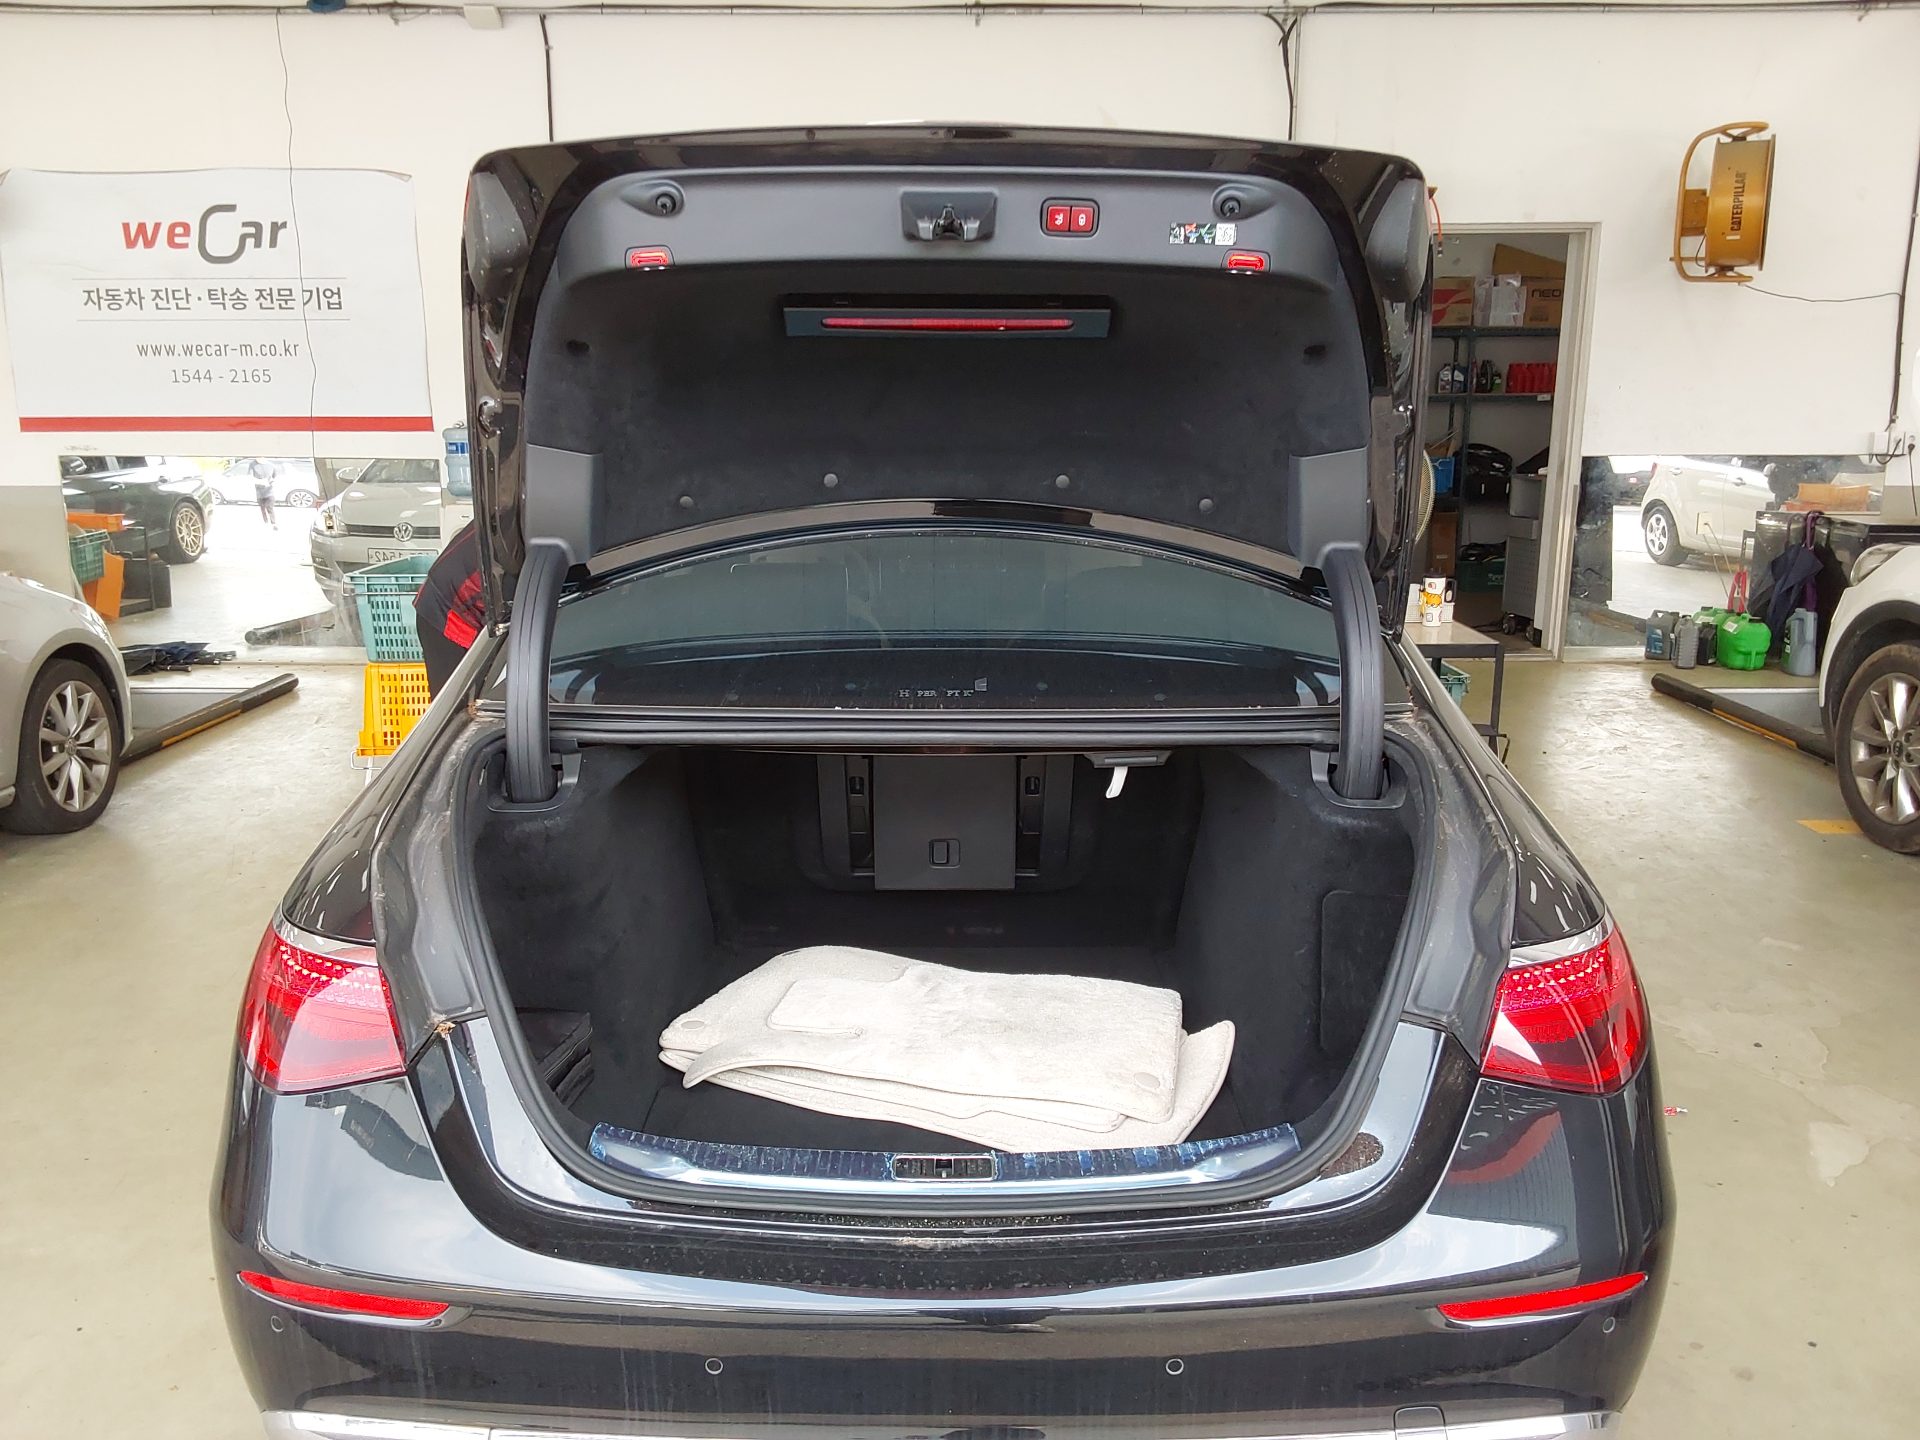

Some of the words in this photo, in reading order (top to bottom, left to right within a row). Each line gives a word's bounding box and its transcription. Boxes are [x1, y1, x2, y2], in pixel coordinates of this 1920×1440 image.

[1730, 170, 1746, 231] CATERPILLAR
[121, 203, 288, 265] weCar
[82, 287, 146, 312] 자동차
[254, 287, 297, 311] 전문
[302, 287, 343, 311] 기업
[136, 338, 300, 357] www.wecar-m.co.kr
